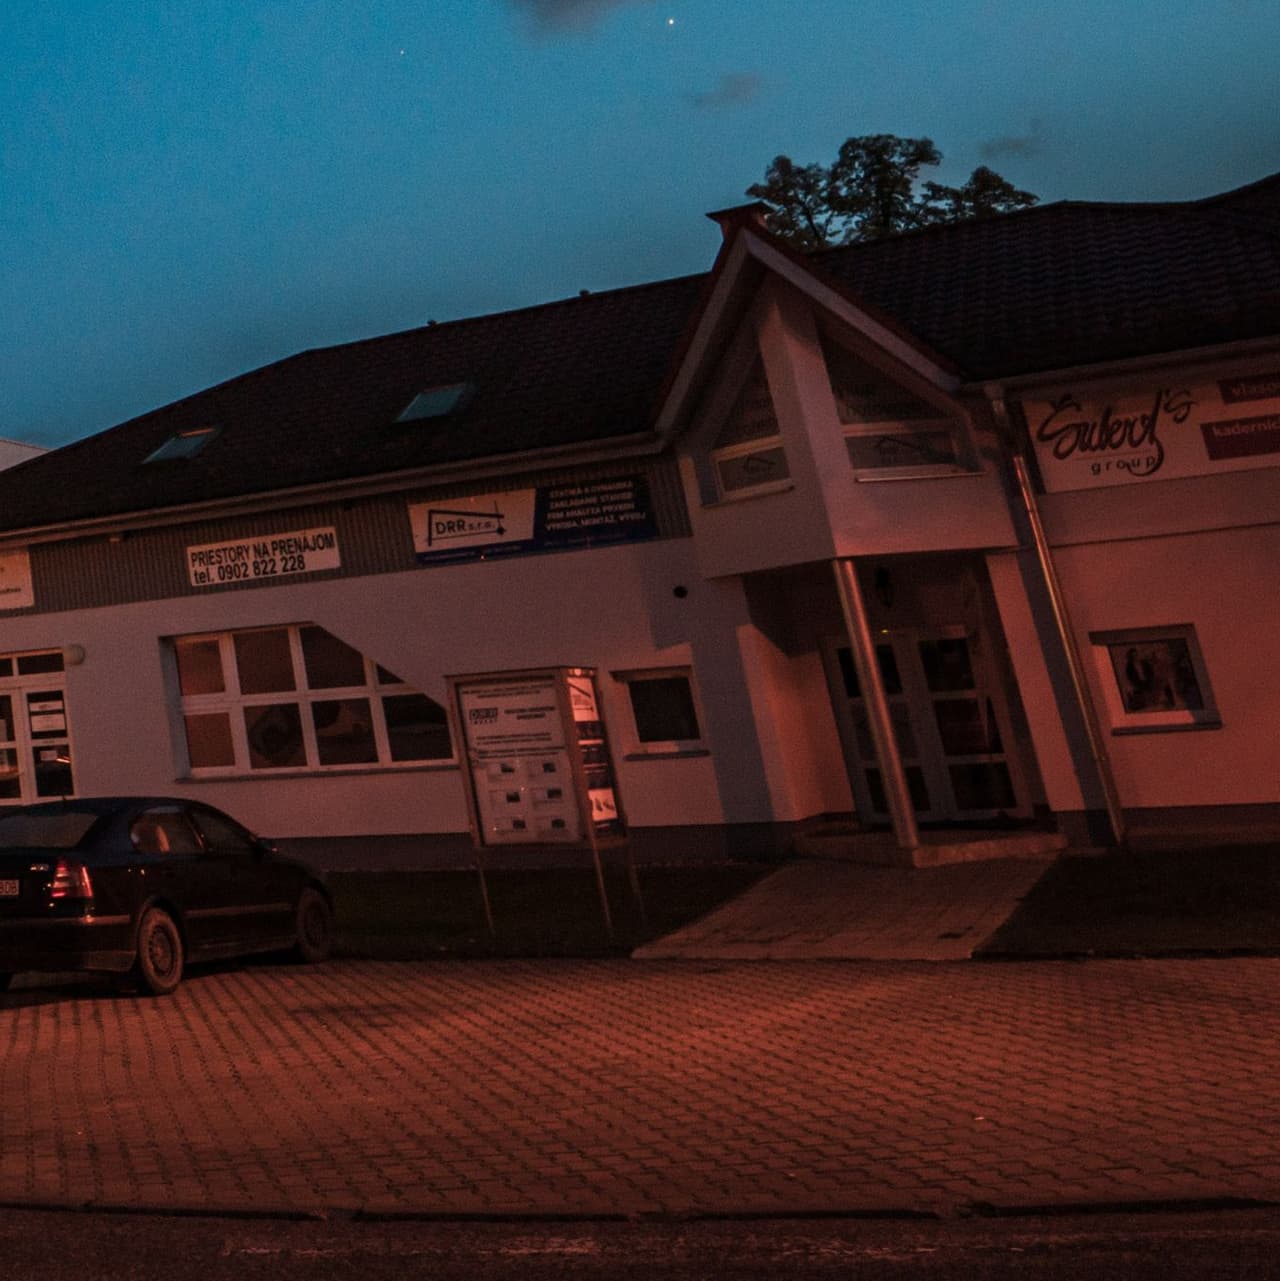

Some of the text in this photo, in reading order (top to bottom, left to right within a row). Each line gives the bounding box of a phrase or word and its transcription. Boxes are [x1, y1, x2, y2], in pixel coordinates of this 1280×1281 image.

[1091, 454, 1154, 475] group
[435, 519, 466, 535] DRR
[191, 545, 251, 567] PRIESTORY
[253, 542, 271, 559] NA
[194, 554, 305, 585] tel. 0902 822 228
